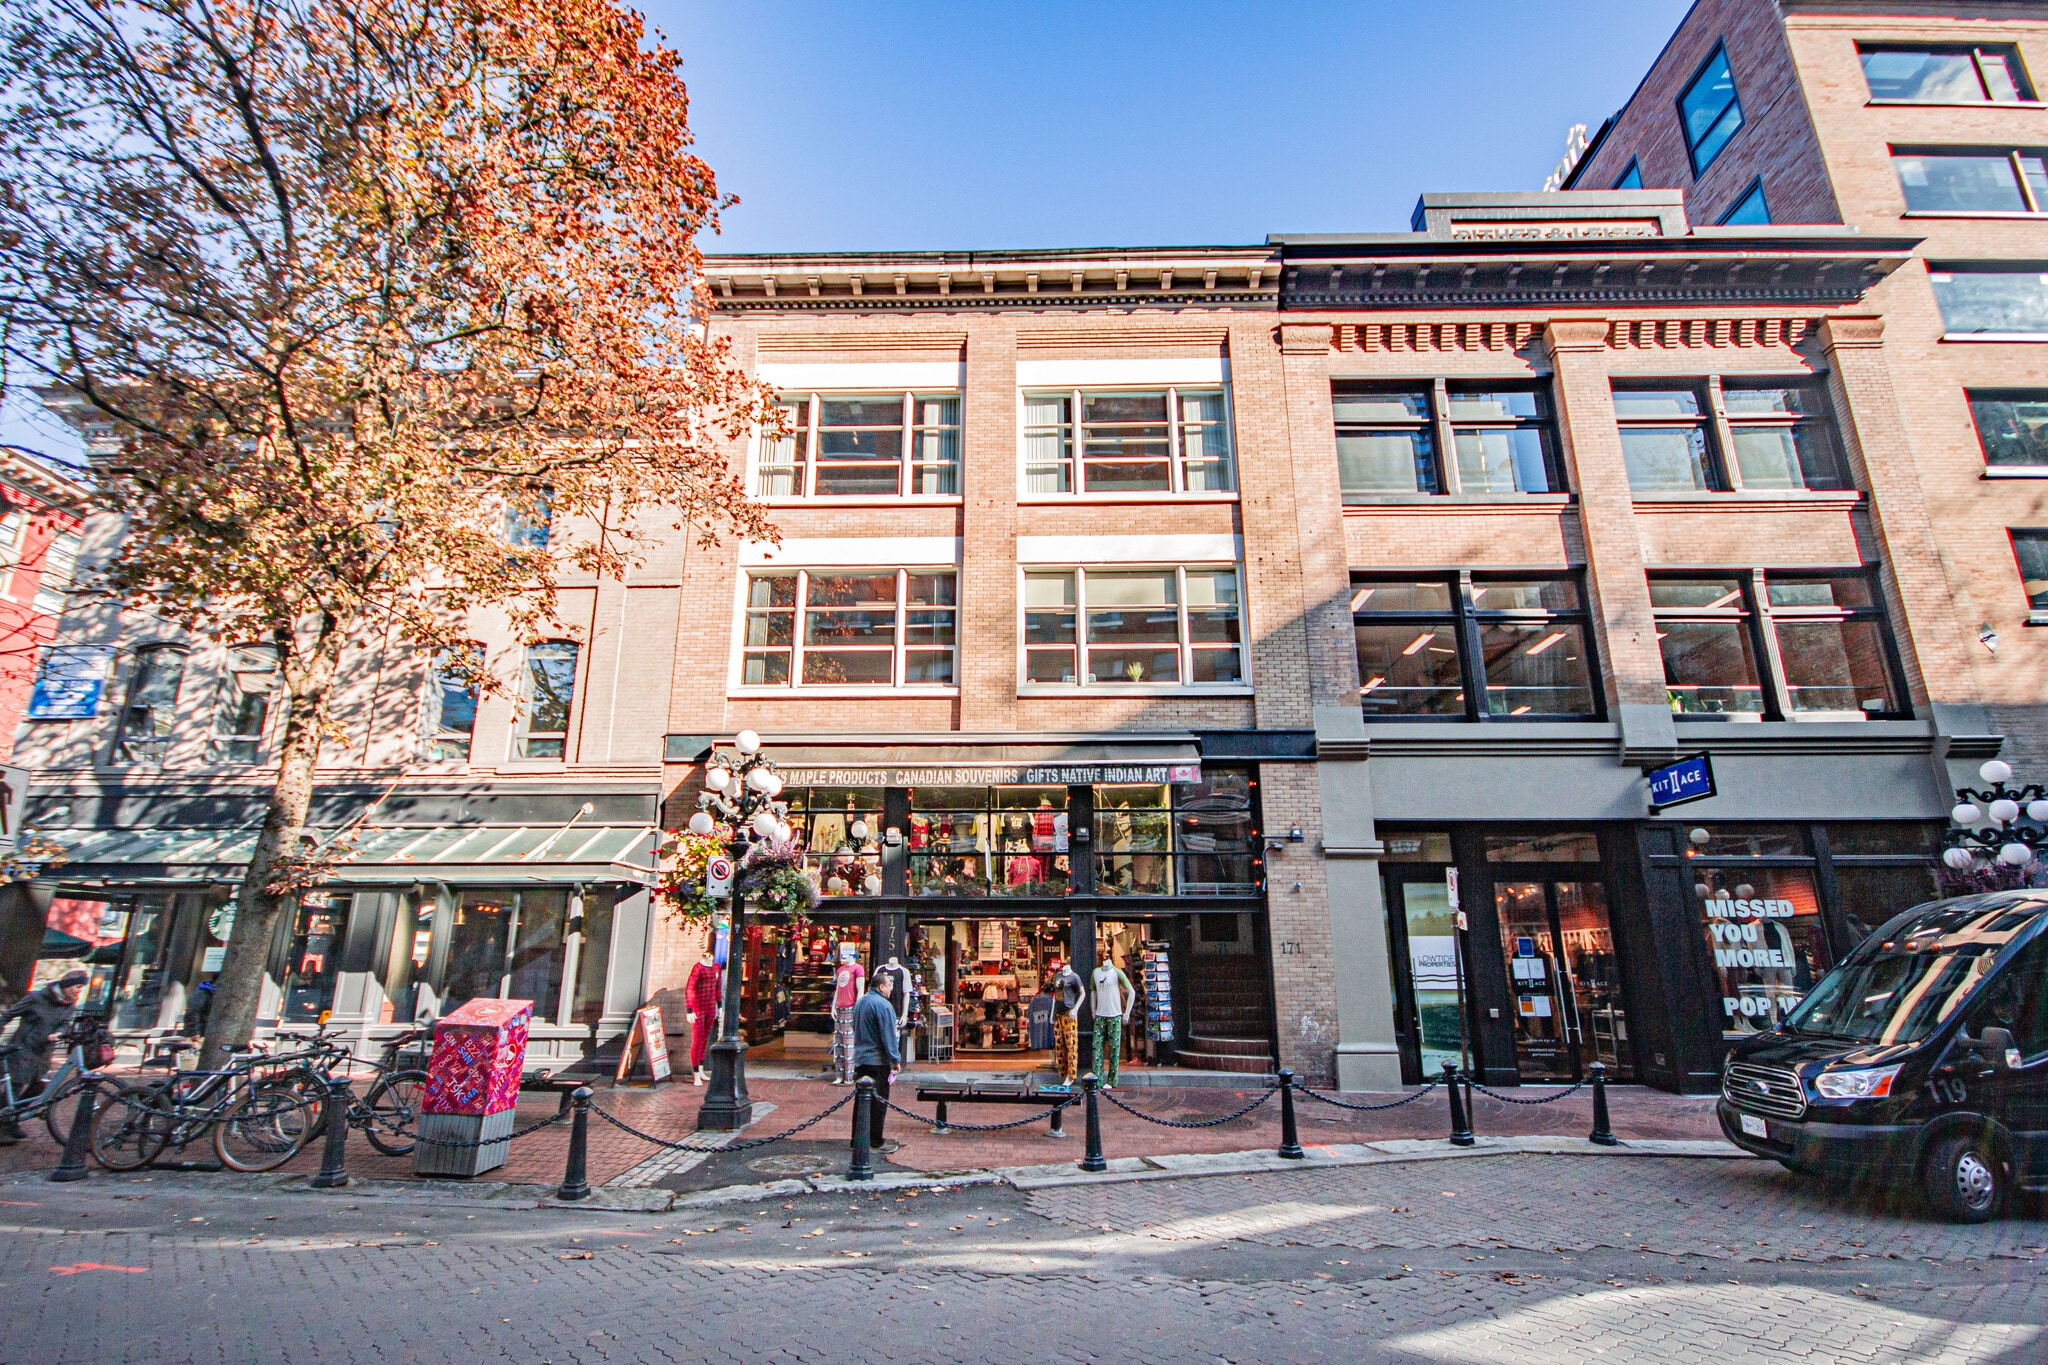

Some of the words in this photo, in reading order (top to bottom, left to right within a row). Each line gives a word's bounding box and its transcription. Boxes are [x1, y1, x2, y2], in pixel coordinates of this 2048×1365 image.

[789, 770, 826, 785] MAPLE
[828, 770, 888, 785] PRODUCTS
[895, 770, 951, 785] CANADIAN
[954, 769, 1018, 784] SOUVENIRS
[1026, 768, 1058, 783] GIFTS
[1061, 768, 1101, 783] NATIVE
[1104, 768, 1142, 783] INDIAN
[1145, 767, 1168, 782] ART
[1652, 779, 1669, 793] KIT
[1681, 769, 1701, 785] ACE
[1705, 899, 1795, 917] MISSED
[888, 914, 896, 950] 175
[1709, 924, 1758, 942] YOU
[1043, 945, 1060, 953] KIDS
[1280, 941, 1302, 954] 171
[1723, 997, 1771, 1016] POP
[1923, 1078, 1967, 1103] 119
